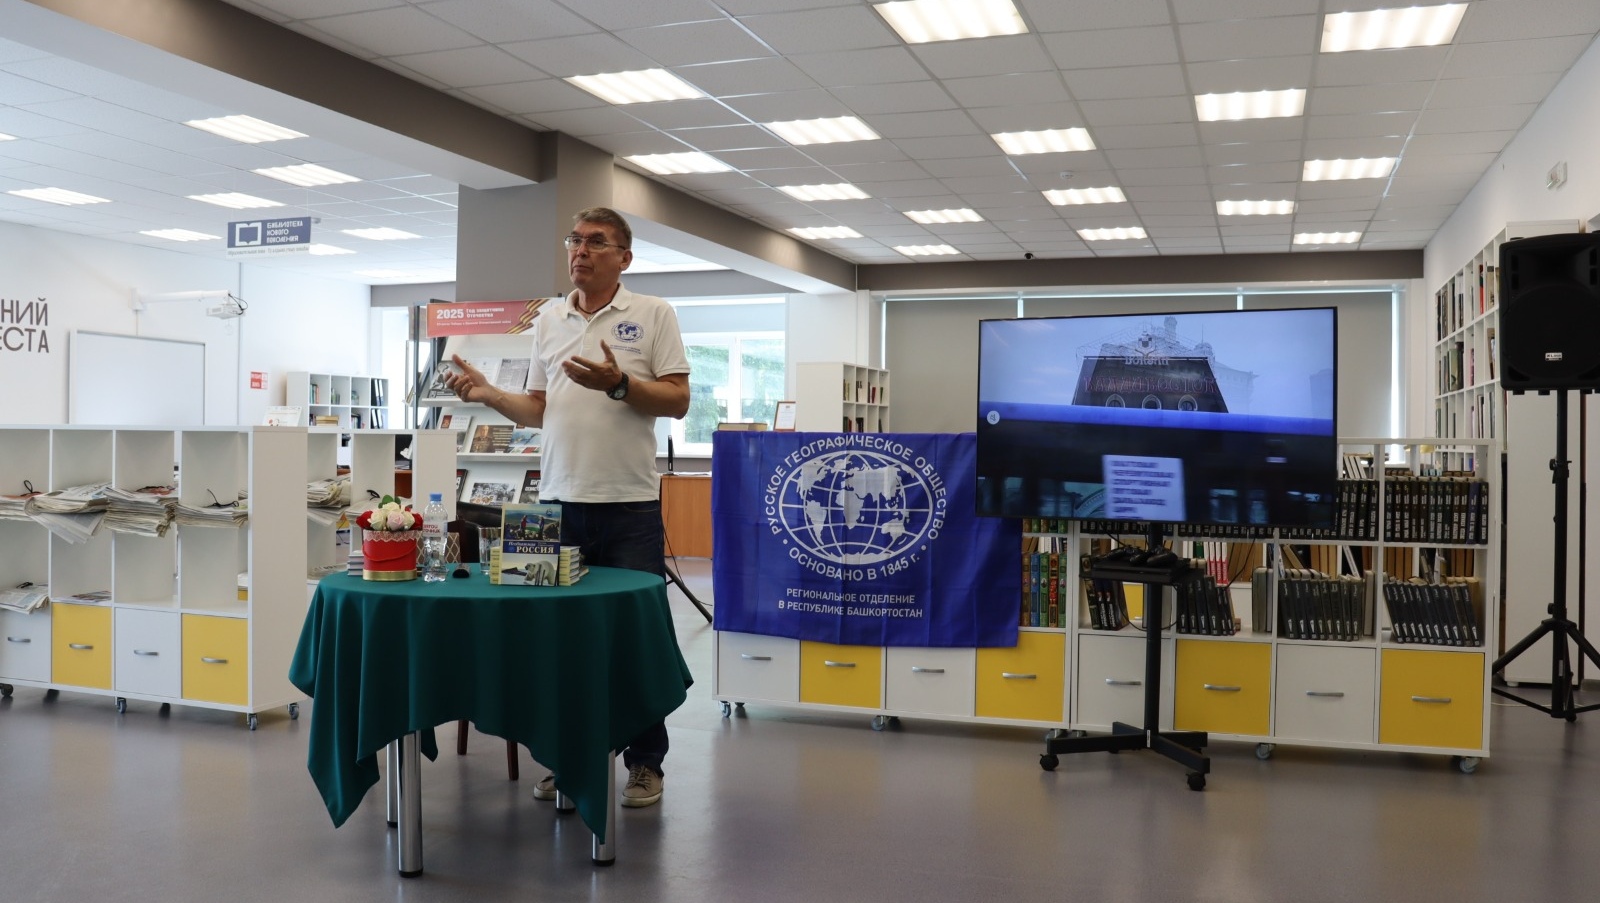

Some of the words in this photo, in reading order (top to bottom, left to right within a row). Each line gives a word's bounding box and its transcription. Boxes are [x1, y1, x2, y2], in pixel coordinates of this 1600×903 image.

[266, 220, 303, 229] БИБЛИОТЕКА
[266, 228, 289, 236] НОВОГО
[436, 308, 464, 319] 2025
[0, 326, 49, 353] СТА
[764, 465, 787, 535] РУССКОЕ
[784, 435, 914, 467] ГЕОГРАФИЧЕСКОЕ
[914, 456, 947, 540] ОБЩЕСТВО
[789, 547, 863, 581] ОСНОВАНО
[867, 568, 877, 580] В
[880, 557, 909, 577] 1845
[910, 553, 920, 563] г.
[786, 588, 857, 602] РЕГИОНАЛЬНОЕ
[859, 594, 915, 604] ОТДЕЛЕНИЕ
[778, 600, 785, 609] В
[787, 601, 844, 615] РЕСПУБЛИКЕ
[847, 607, 923, 617] БАШКОРТОСТАН
